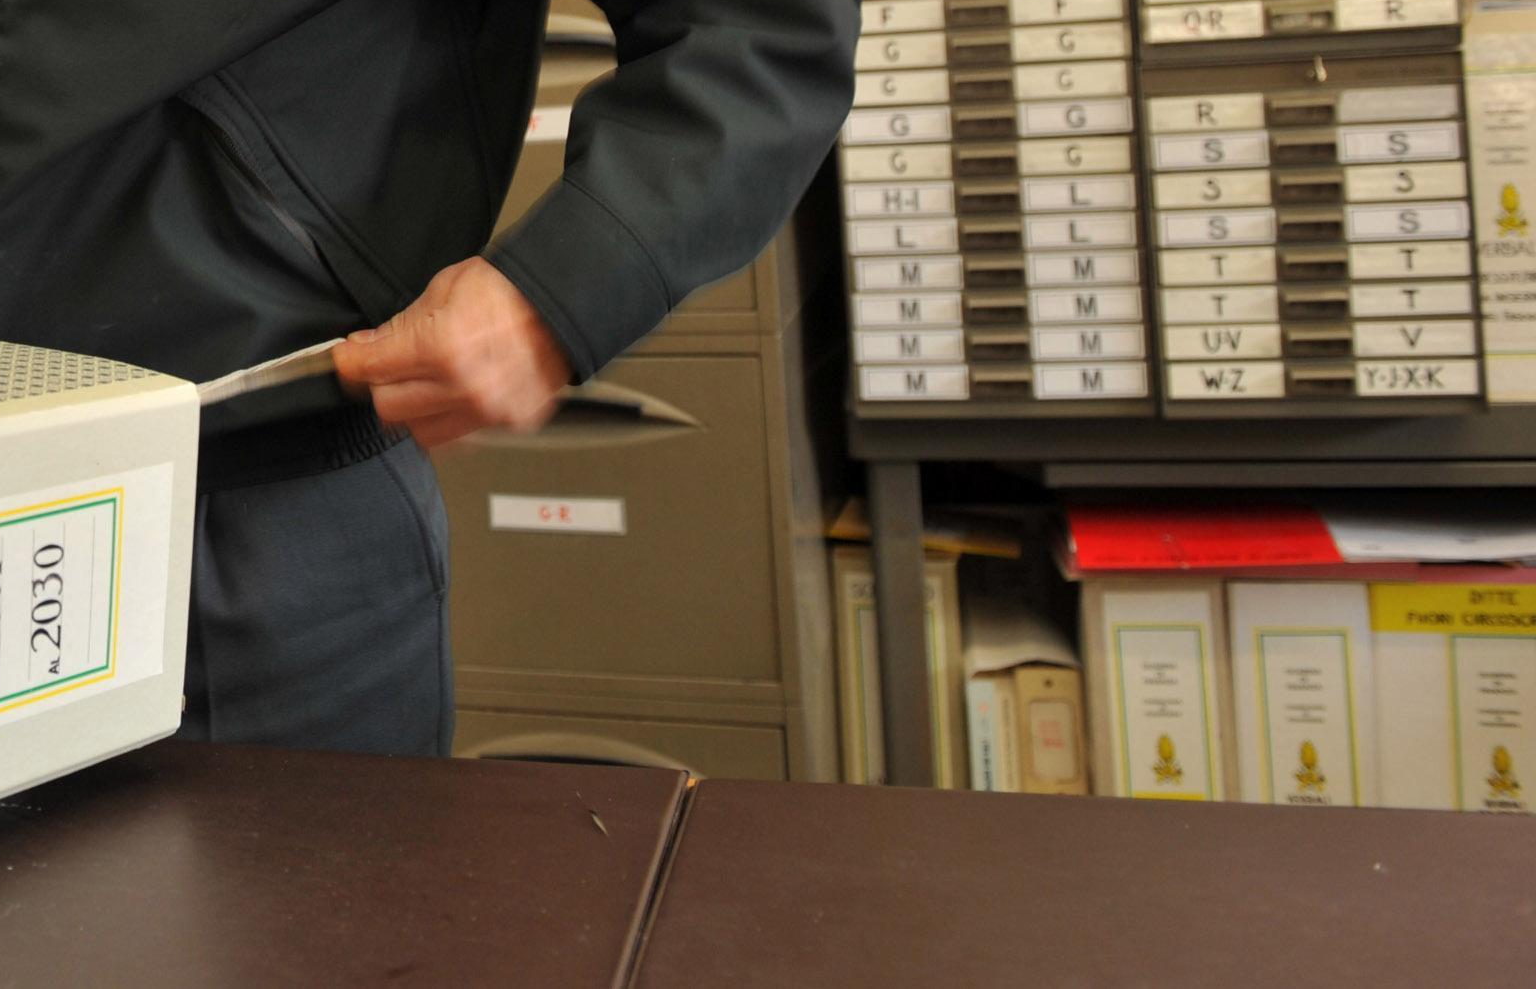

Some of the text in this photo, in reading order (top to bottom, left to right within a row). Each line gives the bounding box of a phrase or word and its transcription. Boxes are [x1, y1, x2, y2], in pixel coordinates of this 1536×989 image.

[1385, 0, 1405, 20] R
[1196, 103, 1217, 125] R
[1071, 184, 1089, 204] L
[896, 228, 915, 247] L
[1070, 222, 1090, 243] L
[1074, 260, 1094, 279] M
[1211, 255, 1226, 277] T
[1401, 249, 1418, 270] T
[901, 265, 920, 283] M
[1077, 296, 1096, 315] M
[1211, 295, 1227, 317] T
[1402, 289, 1418, 308] T
[901, 302, 920, 320] M
[900, 338, 920, 356] M
[1081, 333, 1101, 352] M
[1401, 327, 1422, 348] V
[907, 373, 926, 392] M
[1083, 370, 1102, 390] M
[31, 544, 64, 675] AL 2030
